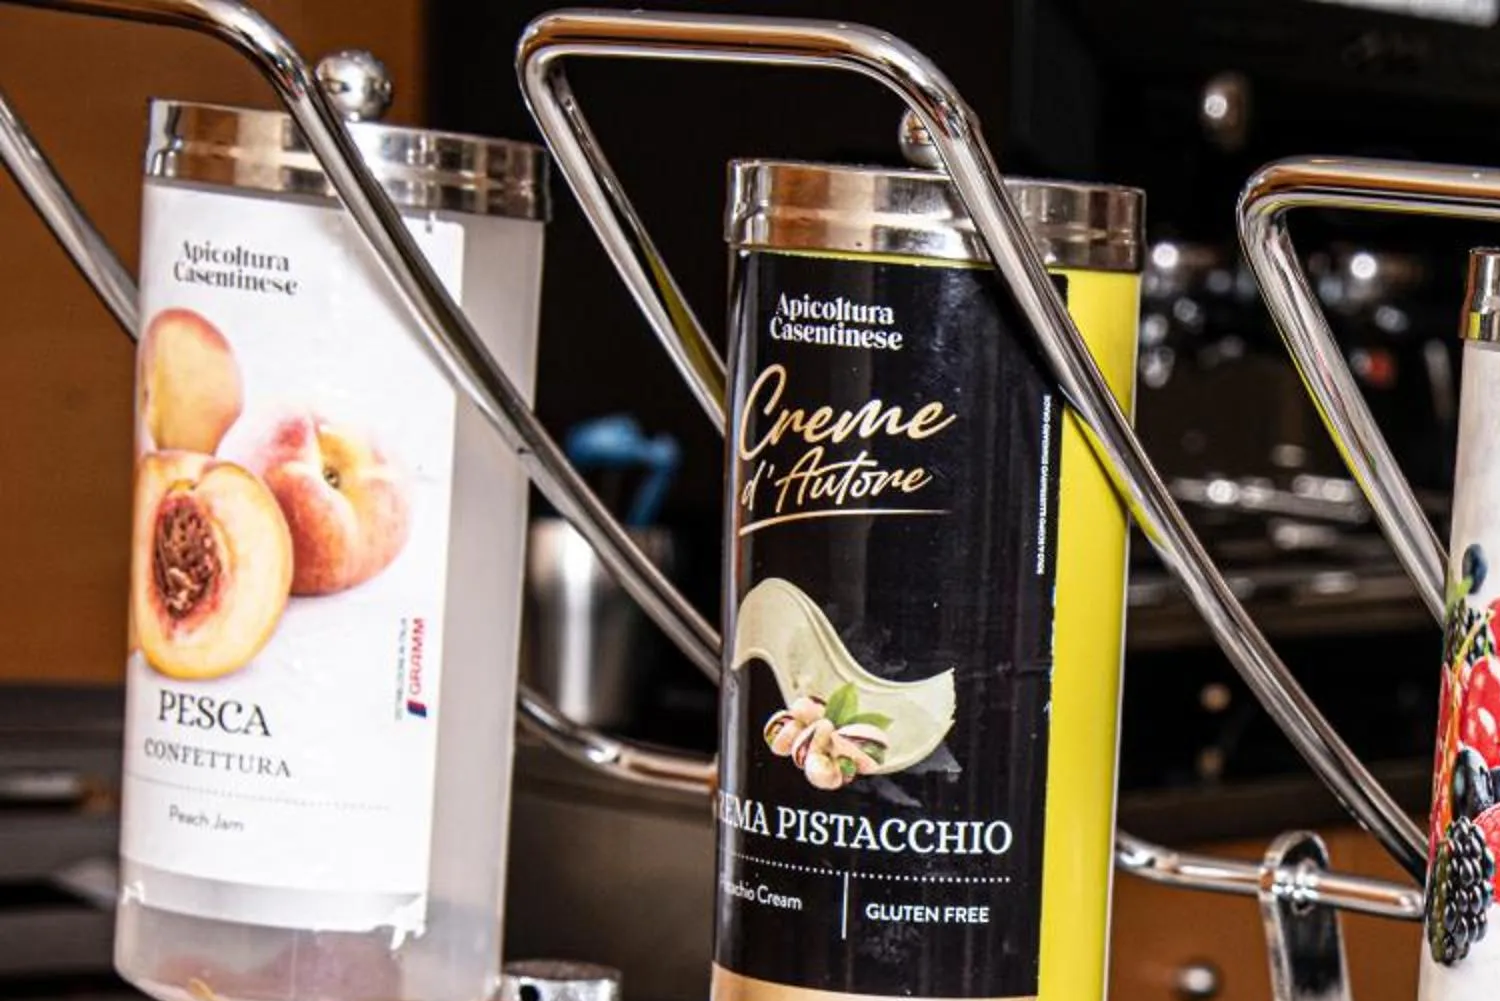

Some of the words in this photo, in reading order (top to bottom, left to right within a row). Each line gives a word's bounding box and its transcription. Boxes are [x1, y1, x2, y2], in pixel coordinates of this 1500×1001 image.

[183, 240, 290, 272] Apicoltura
[173, 261, 299, 296] Casentinese
[776, 292, 895, 325] Apicoltura
[769, 316, 903, 350] Casentinese
[740, 363, 957, 460] Creme
[741, 445, 934, 513] d'Autore
[158, 689, 272, 737] PESCA
[144, 737, 292, 778] CONFETTURA
[168, 804, 210, 827] Peach
[213, 814, 245, 832] Jam
[775, 805, 1013, 855] PISTACCHIO
[757, 884, 804, 911] Cream
[865, 902, 939, 924] GLUTEN
[944, 905, 990, 924] FREE
